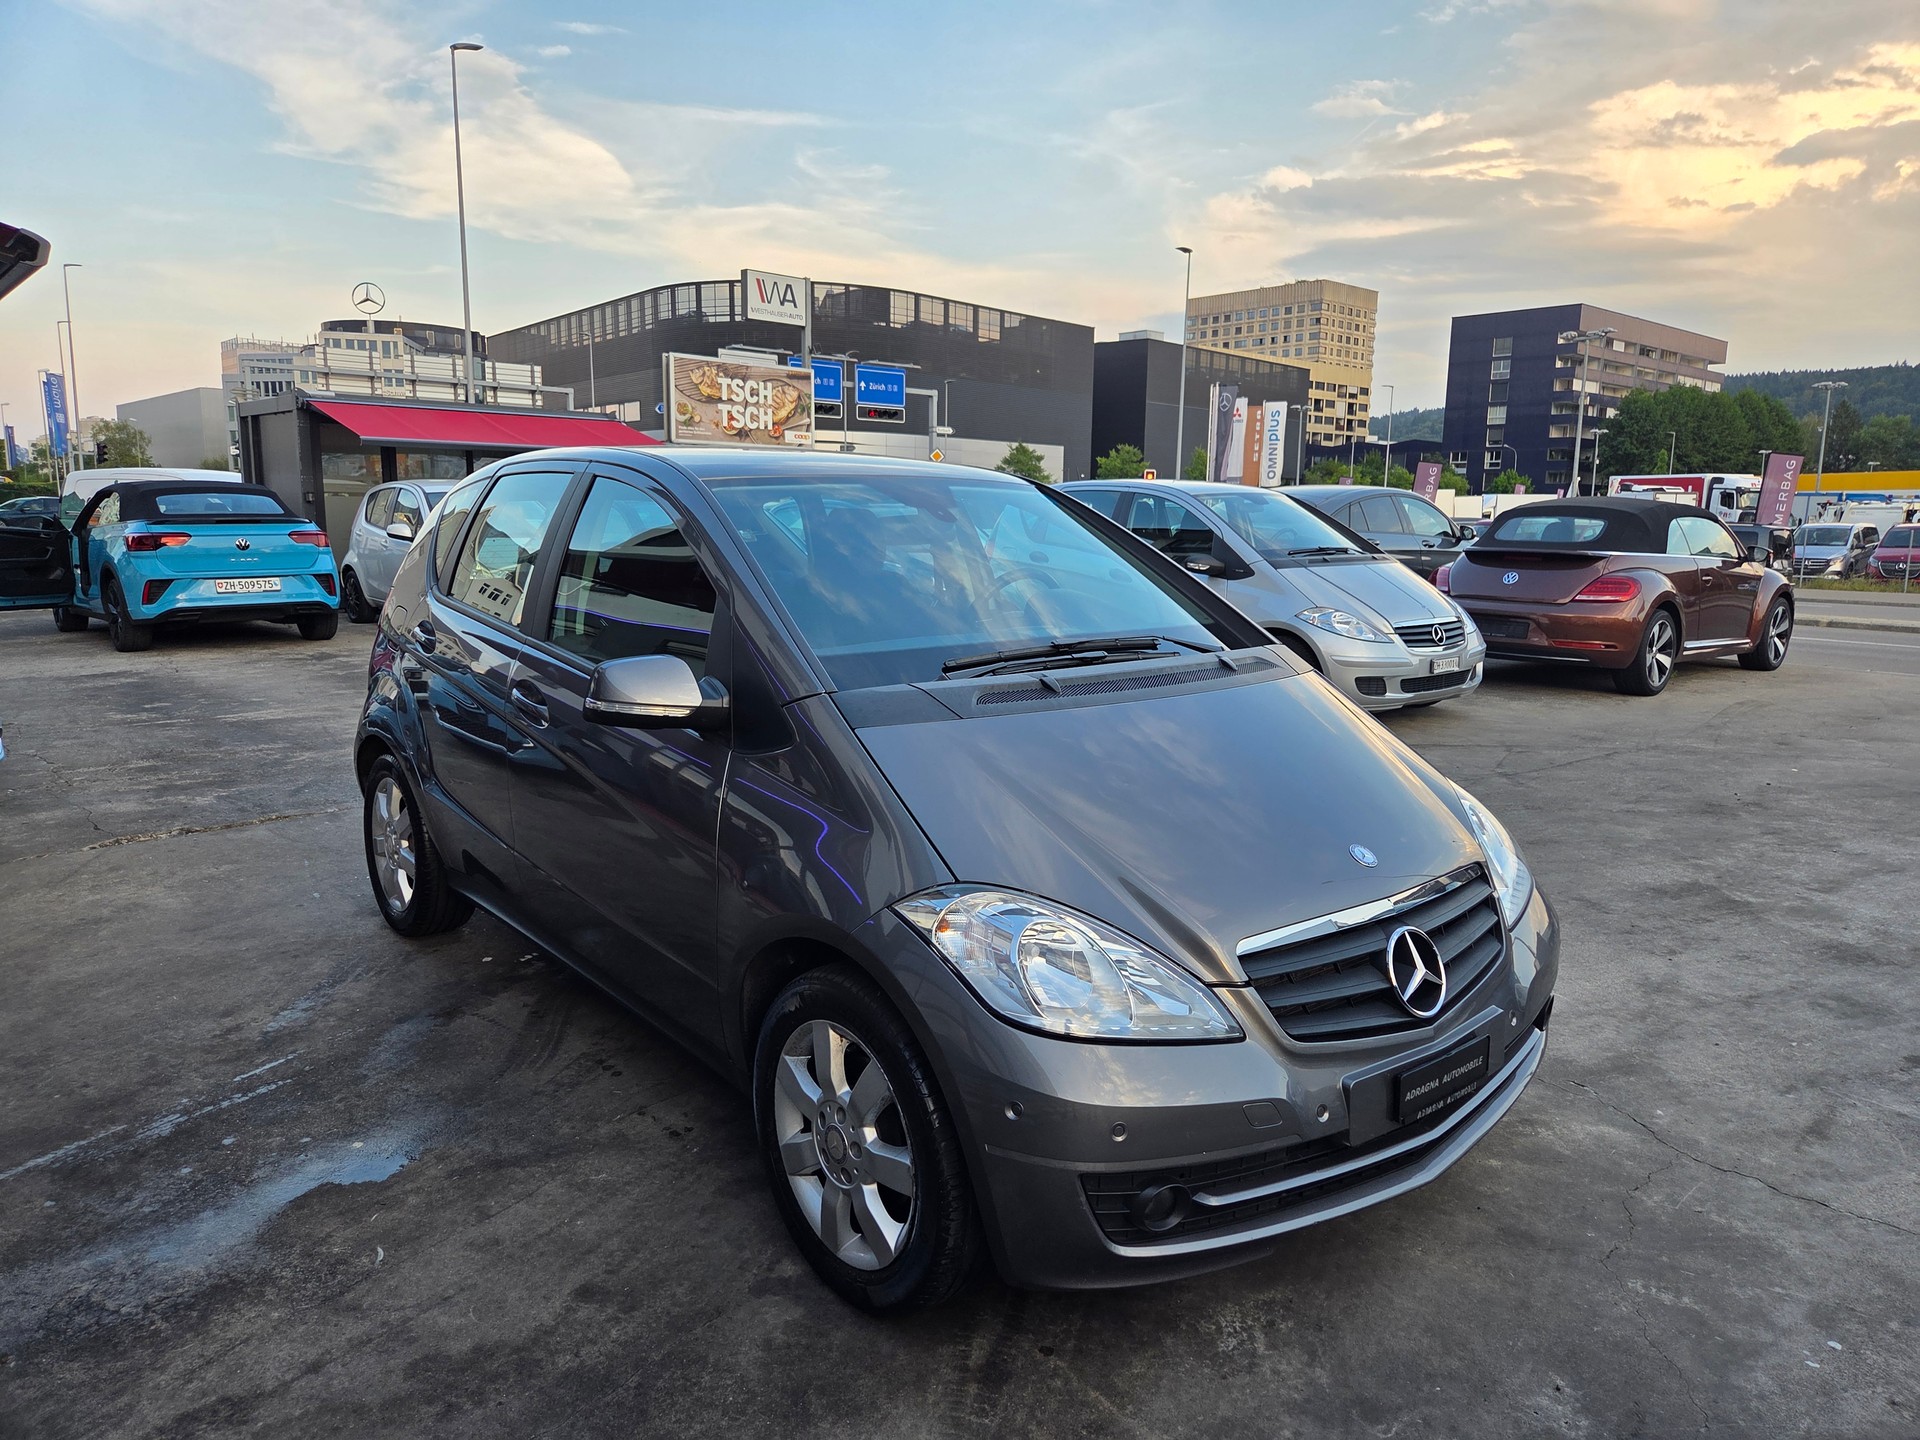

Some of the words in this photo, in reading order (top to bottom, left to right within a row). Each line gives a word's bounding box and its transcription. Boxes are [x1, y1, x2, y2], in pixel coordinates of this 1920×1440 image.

[717, 377, 773, 405] TSCH
[868, 381, 886, 392] Zürich
[717, 403, 773, 431] TSCH
[1253, 409, 1263, 462] SETRA
[1773, 459, 1797, 525] MERBAG
[1404, 1078, 1440, 1102] ADRAGNA
[1442, 1055, 1484, 1084] AUTOMOBILE
